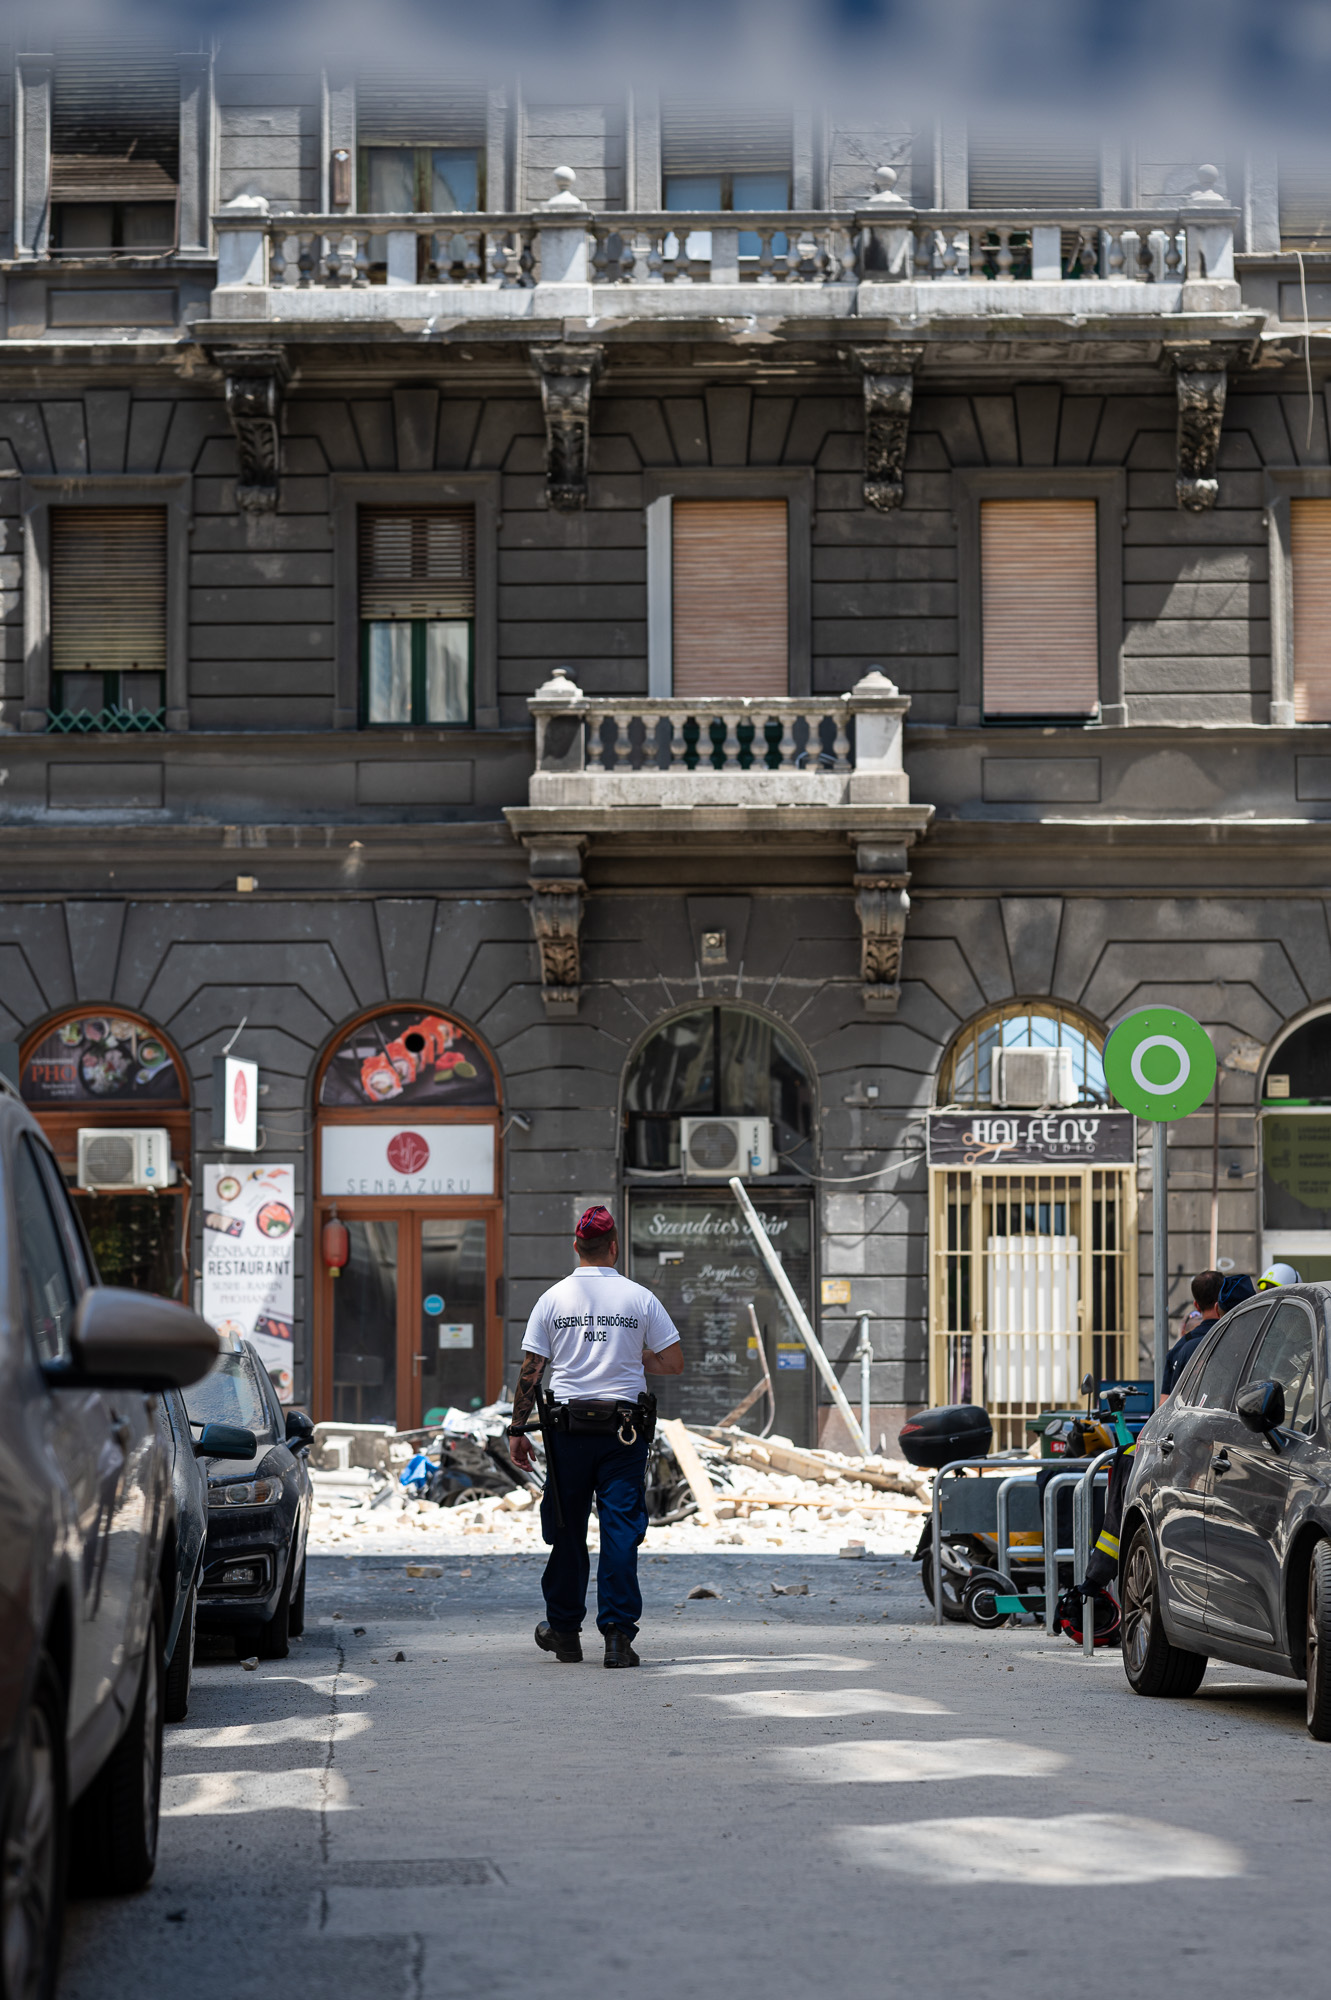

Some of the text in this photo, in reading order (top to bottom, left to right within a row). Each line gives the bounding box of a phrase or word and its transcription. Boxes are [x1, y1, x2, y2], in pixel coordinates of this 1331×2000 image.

[31, 1065, 77, 1082] PHO
[972, 1114, 1100, 1146] HAJ-FÉNY
[1025, 1143, 1096, 1154] STUDIO
[346, 1178, 471, 1195] SENBAZURU
[649, 1213, 740, 1236] Szendvics
[208, 1261, 290, 1275] RESTAURANT
[553, 1313, 639, 1330] KÉSZENLÉTI RENDŐRSÉG
[584, 1331, 607, 1342] POLICE
[1053, 1443, 1066, 1452] SU
